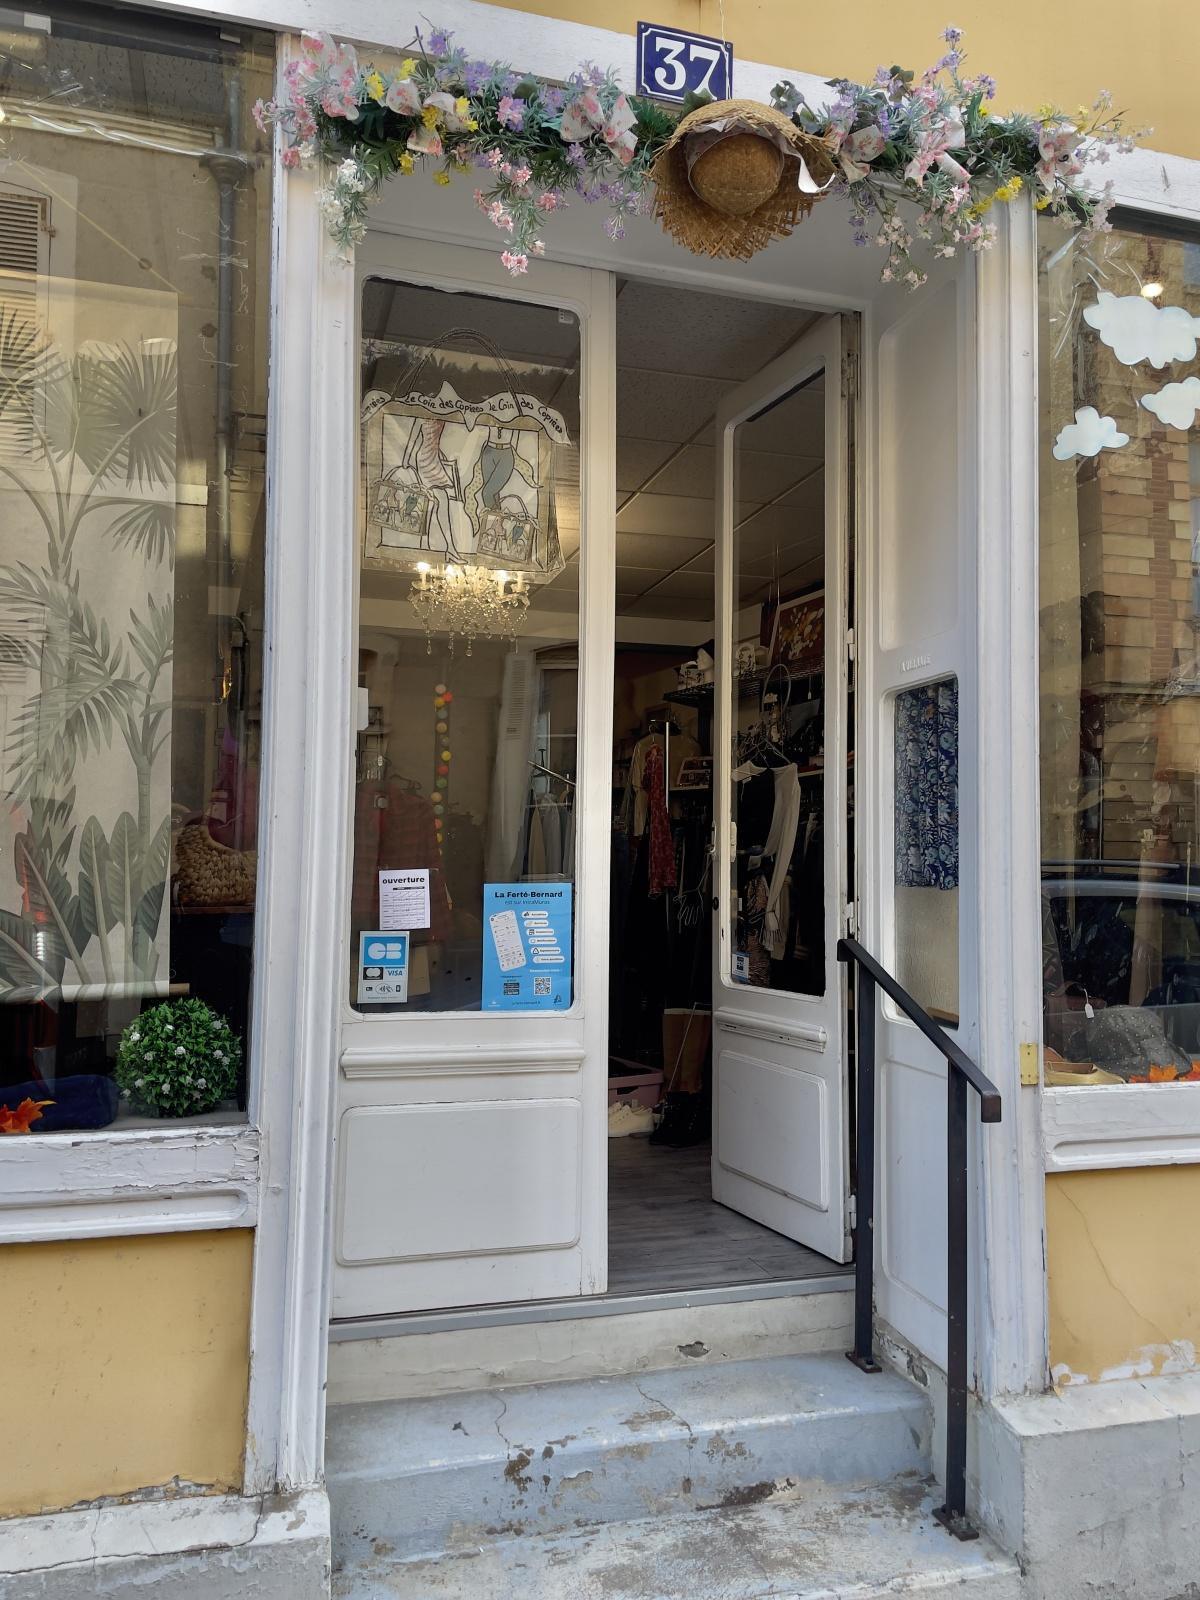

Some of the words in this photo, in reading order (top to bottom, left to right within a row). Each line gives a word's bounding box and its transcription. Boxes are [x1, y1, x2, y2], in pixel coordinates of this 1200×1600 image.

[654, 36, 721, 101] 37
[418, 394, 436, 409] Coin
[438, 396, 454, 409] des
[498, 398, 514, 411] Coin
[520, 397, 534, 410] des
[382, 876, 425, 884] ouverture
[367, 942, 402, 960] CB
[387, 969, 403, 977] VISA
